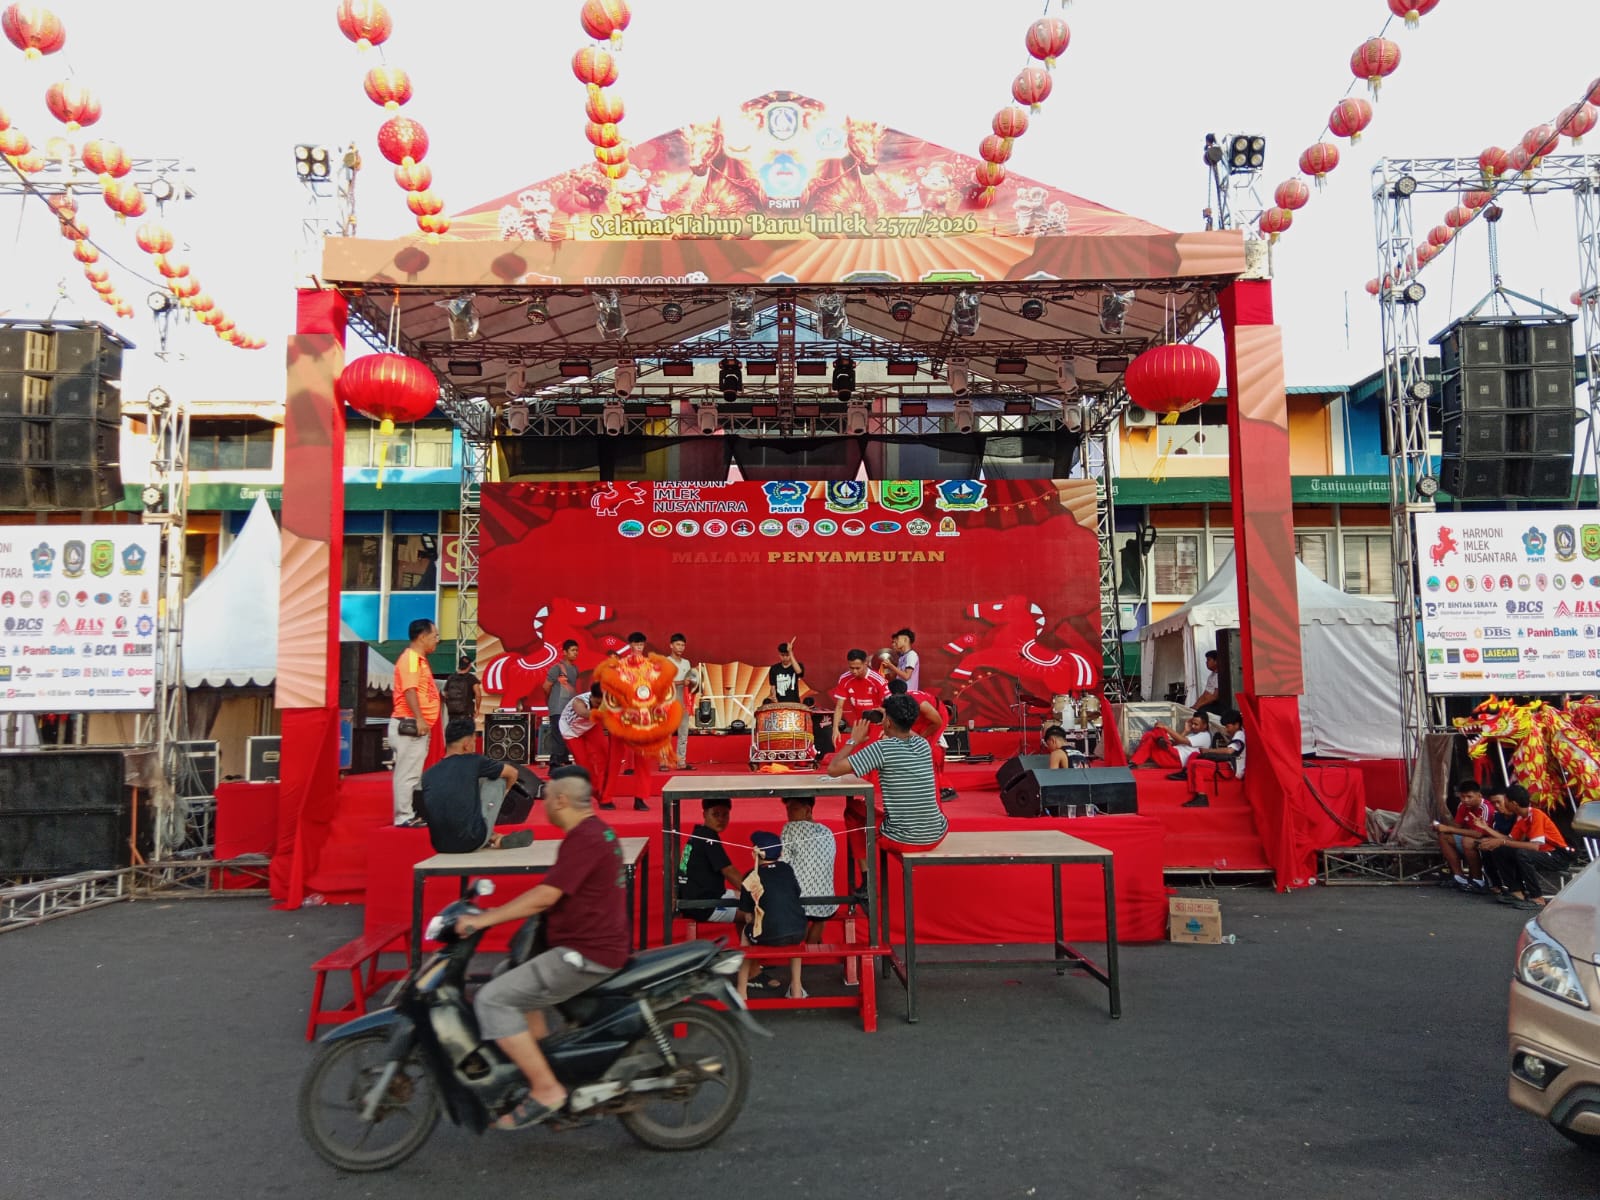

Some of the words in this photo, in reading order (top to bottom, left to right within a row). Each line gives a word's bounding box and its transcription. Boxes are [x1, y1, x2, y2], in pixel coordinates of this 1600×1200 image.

[768, 200, 800, 209] PSMTI
[590, 214, 676, 237] Selamat
[677, 214, 742, 236] Tahun
[745, 213, 801, 234] Baru
[804, 213, 872, 235] Imlek
[874, 215, 978, 238] 2577/2026
[653, 489, 701, 501] IMLEK
[653, 501, 748, 513] NUSANTARA
[1462, 527, 1504, 541] HARMONI
[1463, 540, 1490, 551] IMLEK
[672, 551, 761, 563] MALAM
[768, 551, 945, 563] PENYAMBUTAN
[1464, 552, 1518, 564] NUSANTARA
[1518, 600, 1543, 613] BCS
[16, 618, 43, 630] BCS
[1484, 627, 1511, 638] DBS
[1527, 627, 1579, 639] PaninBank
[23, 645, 75, 656] PaninBank
[95, 644, 117, 656] BCA
